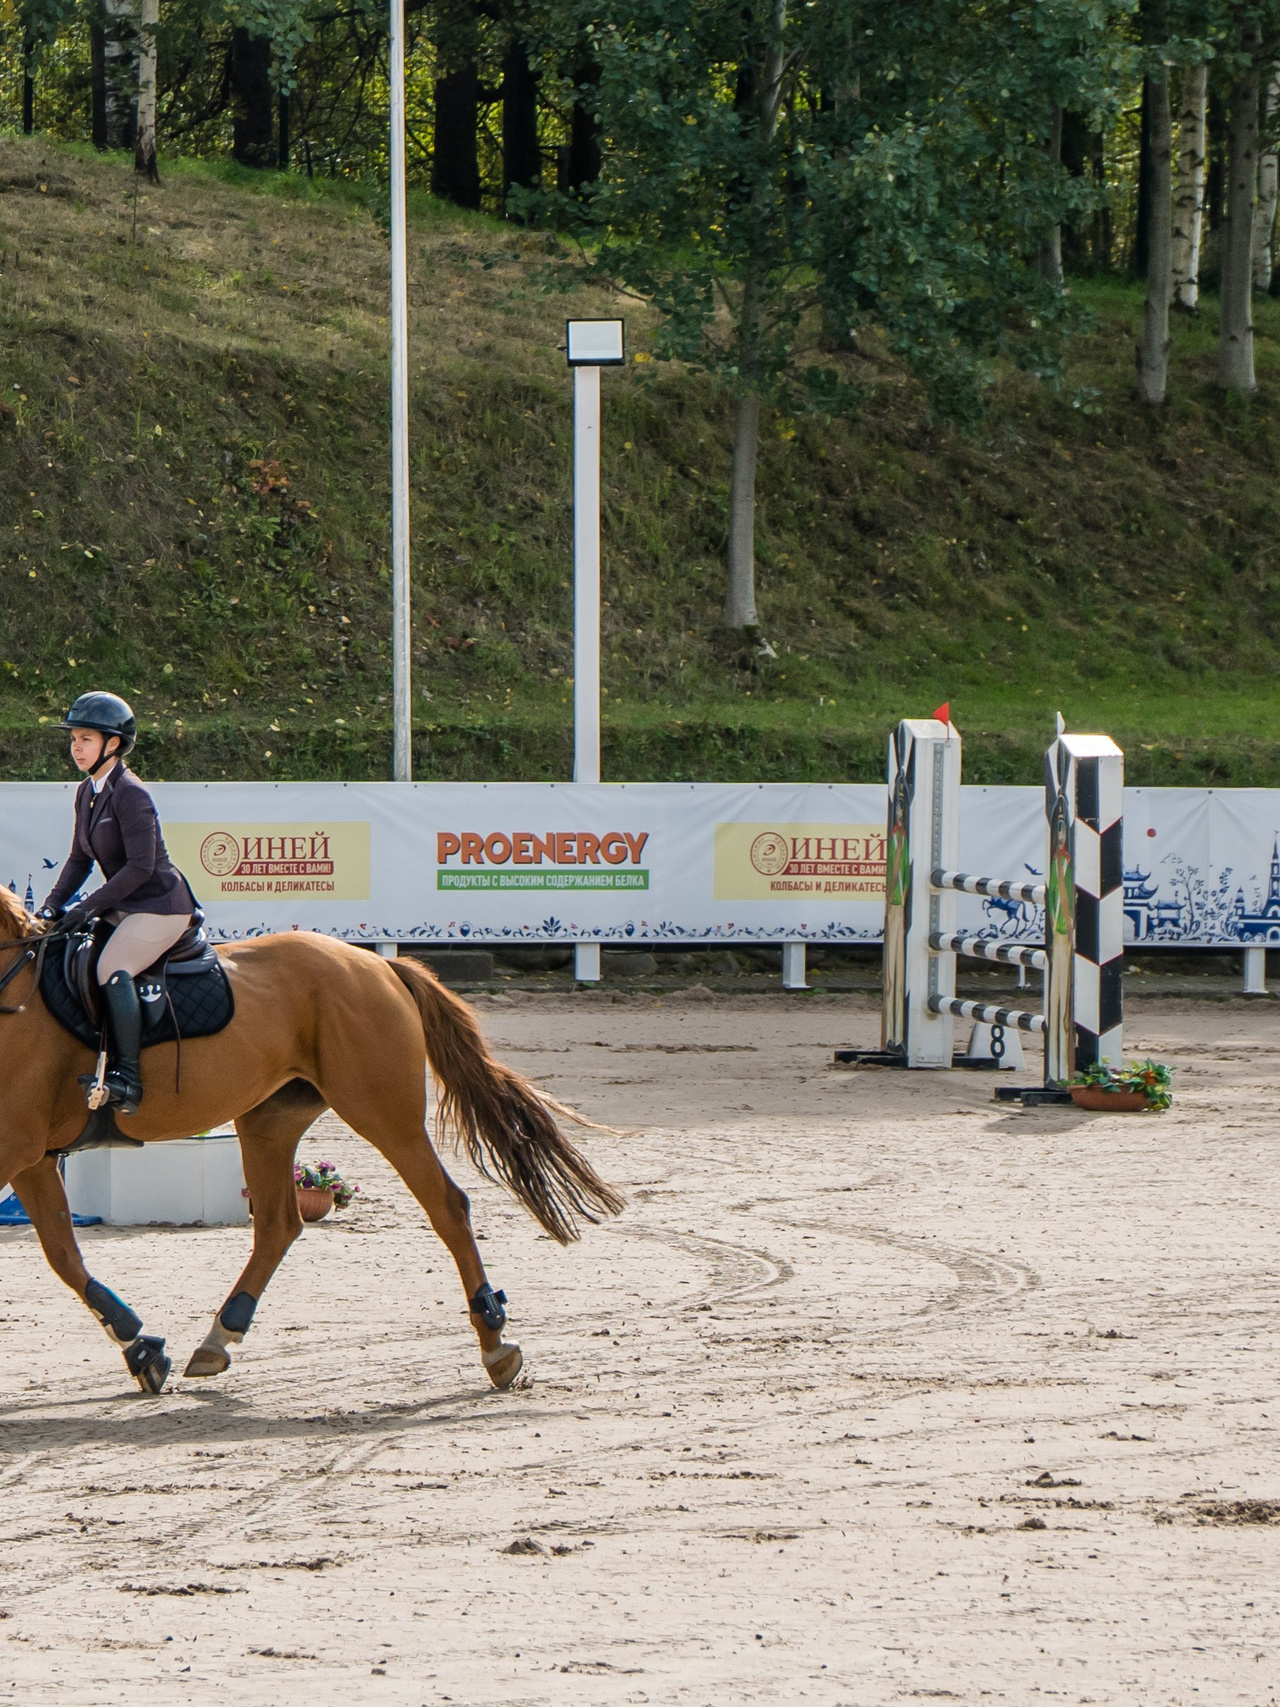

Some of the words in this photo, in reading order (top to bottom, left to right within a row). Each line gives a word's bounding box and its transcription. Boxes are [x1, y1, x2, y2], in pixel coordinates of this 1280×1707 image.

[241, 831, 331, 860] ИНЕЙ
[437, 832, 649, 865] PROENERGY
[790, 833, 887, 861] ИНЕЙ
[241, 864, 251, 875] 30
[252, 864, 267, 875] ЛЕТ
[268, 864, 298, 875] ВМЕСТЕ
[299, 864, 305, 875] С
[306, 863, 332, 874] ВАМИ!
[789, 863, 799, 874] 30
[800, 864, 816, 874] ЛЕТ
[817, 864, 851, 875] ВМЕСТЕ
[851, 864, 858, 875] С
[221, 881, 265, 892] КОЛБАСЫ
[266, 881, 273, 892] И
[274, 880, 335, 893] ДЕЛИКАТЕСЫ
[442, 874, 490, 888] ПРОДУКТЫ
[492, 875, 498, 886] С
[500, 875, 544, 886] ВЫСОКИМ
[546, 874, 613, 888] СОДЕРЖАНИЕМ
[615, 874, 644, 887] БЕЛКА
[770, 880, 813, 892] КОЛБАСЫ
[815, 881, 822, 891] И
[990, 1024, 1006, 1059] 8
